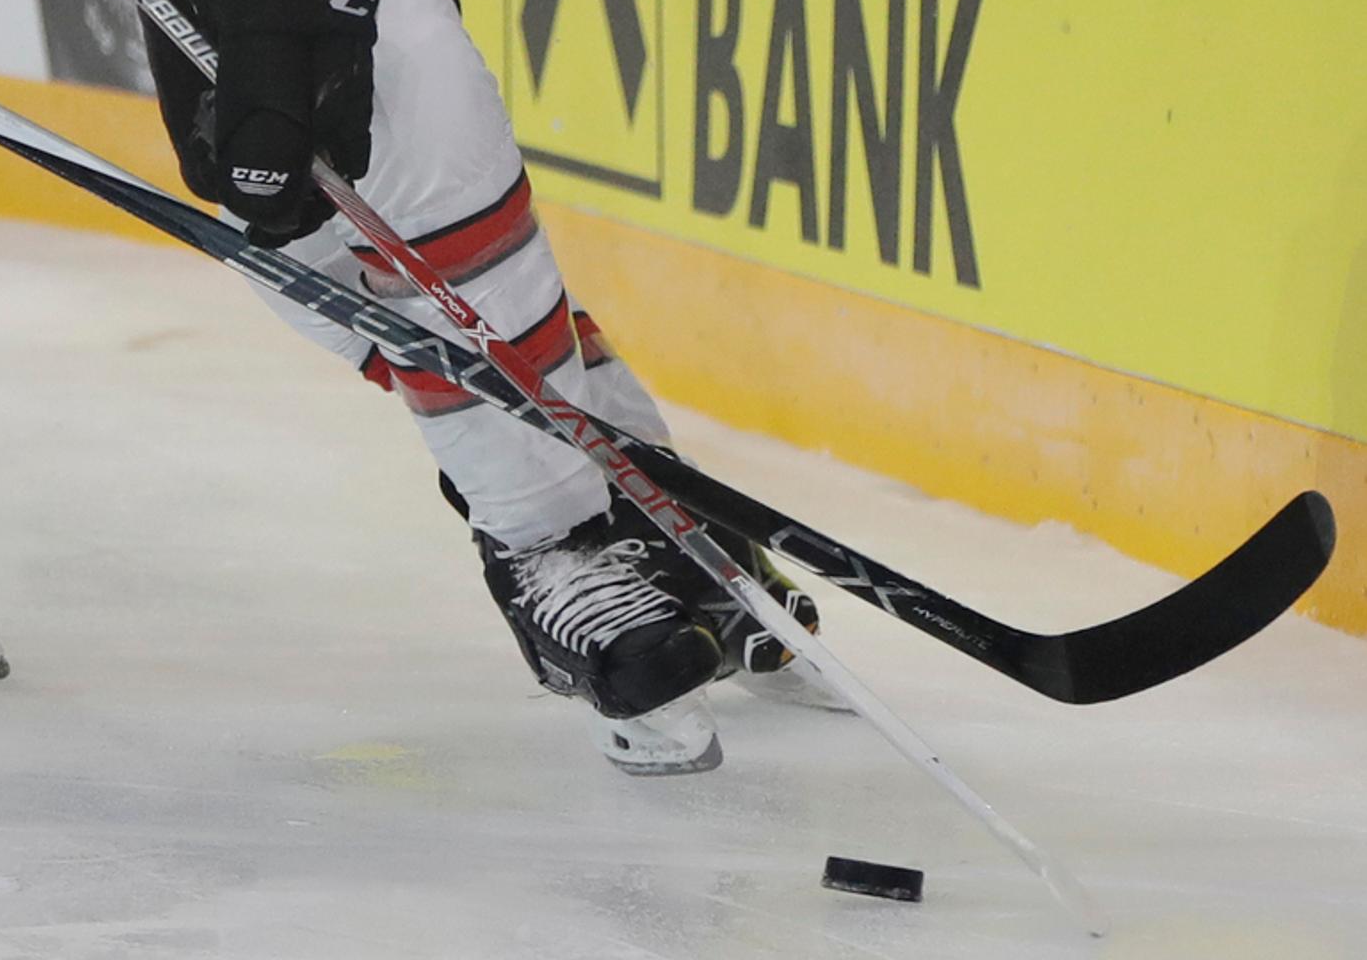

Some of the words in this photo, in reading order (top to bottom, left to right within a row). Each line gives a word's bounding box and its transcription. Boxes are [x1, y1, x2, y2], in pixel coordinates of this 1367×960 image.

[149, 0, 220, 80] BAUE
[231, 166, 289, 184] CCM
[223, 244, 619, 440] STEAL
[534, 372, 698, 535] VAPOR
